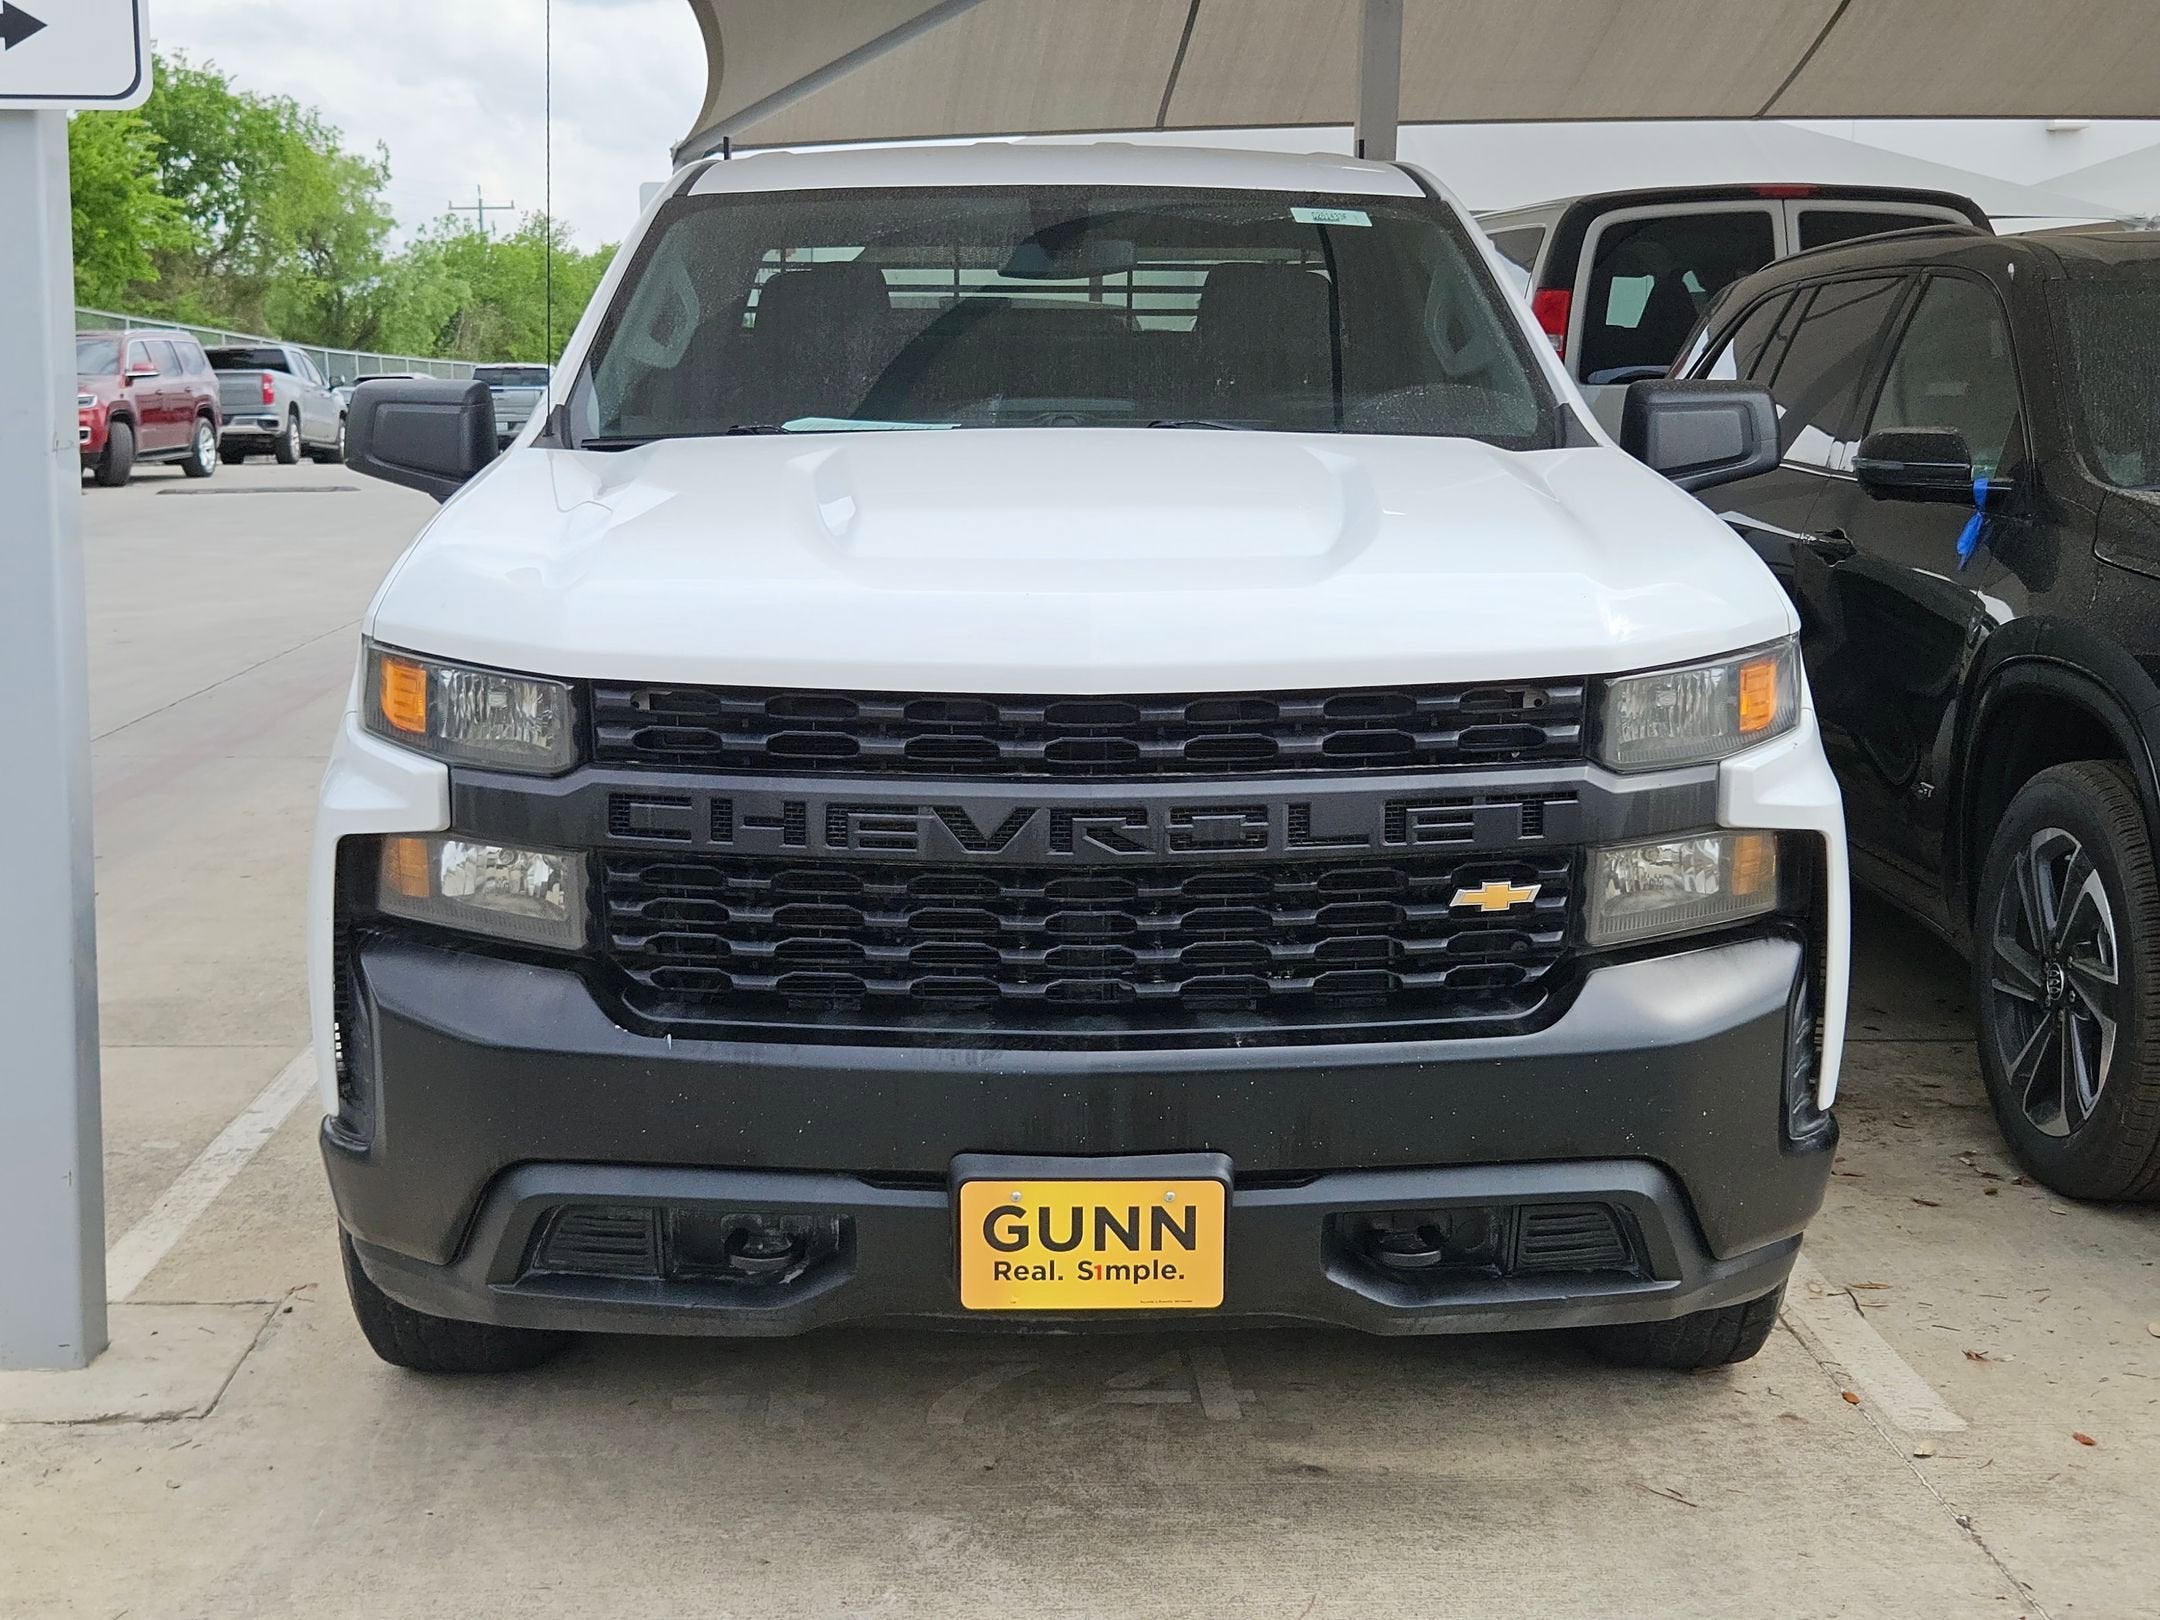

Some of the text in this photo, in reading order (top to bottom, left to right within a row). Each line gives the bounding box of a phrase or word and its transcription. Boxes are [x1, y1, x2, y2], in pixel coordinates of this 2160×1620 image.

[607, 790, 1580, 855] CHEVROLET
[982, 1205, 1196, 1252] GUNN
[993, 1260, 1064, 1281] Real.
